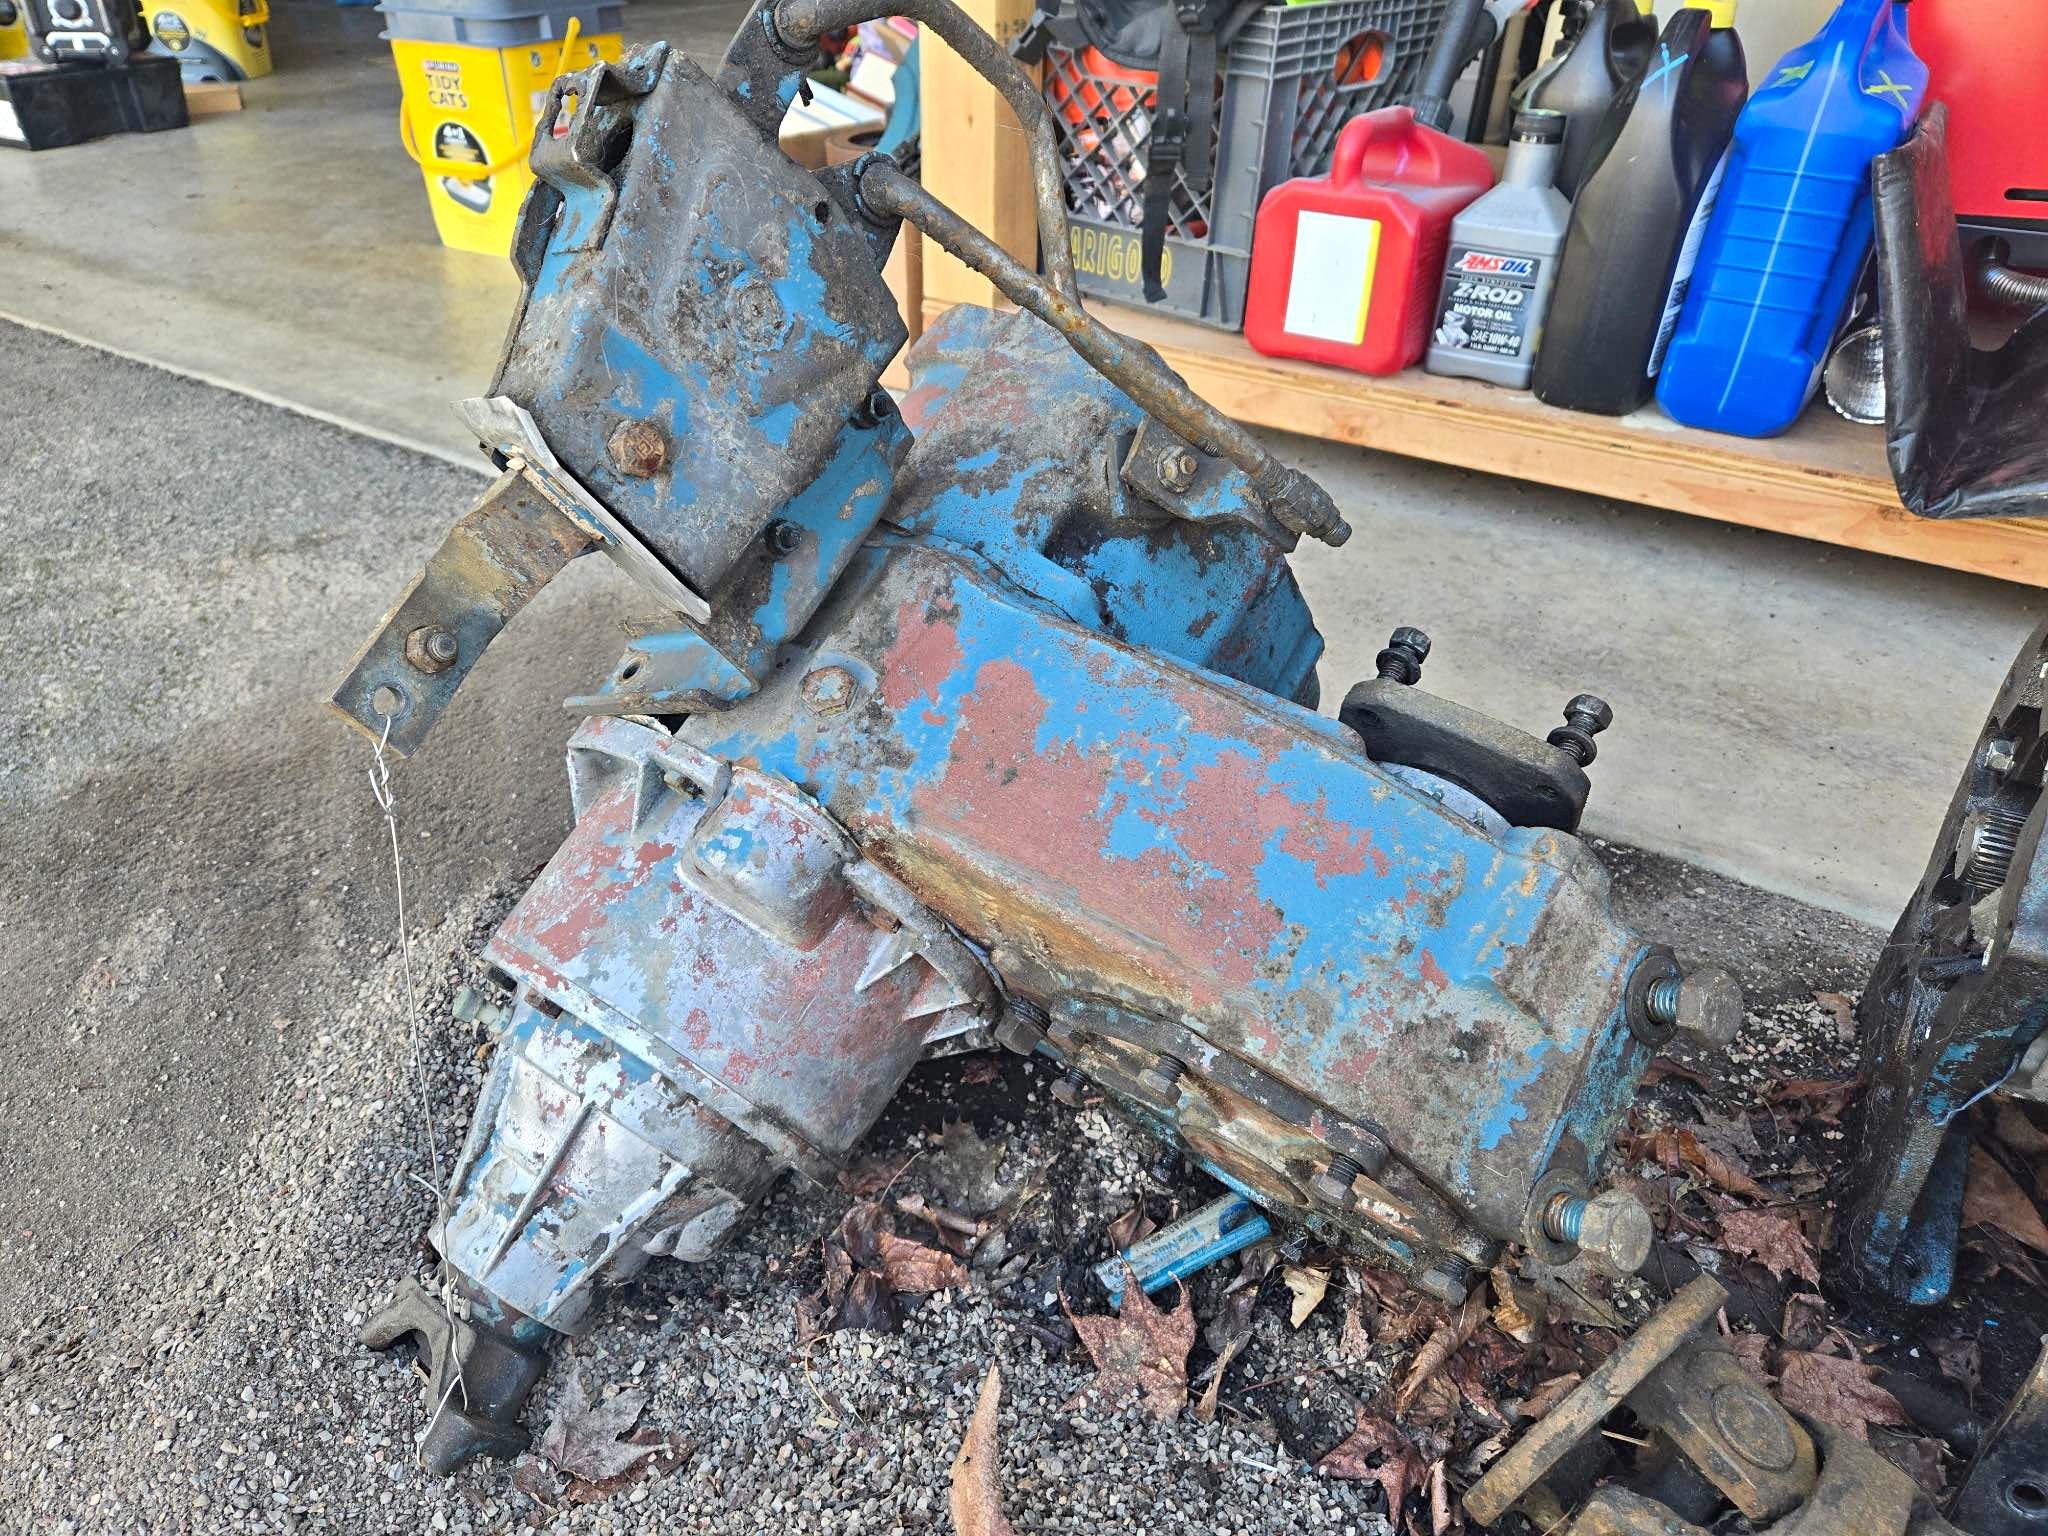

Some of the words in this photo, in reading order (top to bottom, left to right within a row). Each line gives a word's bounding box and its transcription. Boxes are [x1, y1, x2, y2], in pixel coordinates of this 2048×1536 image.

[424, 74, 460, 90] TIDY
[428, 90, 467, 108] CATS
[1457, 252, 1533, 276] AMSOIL
[1454, 303, 1493, 319] MOTOR
[1495, 309, 1513, 321] OIL
[1471, 329, 1490, 343] SAE
